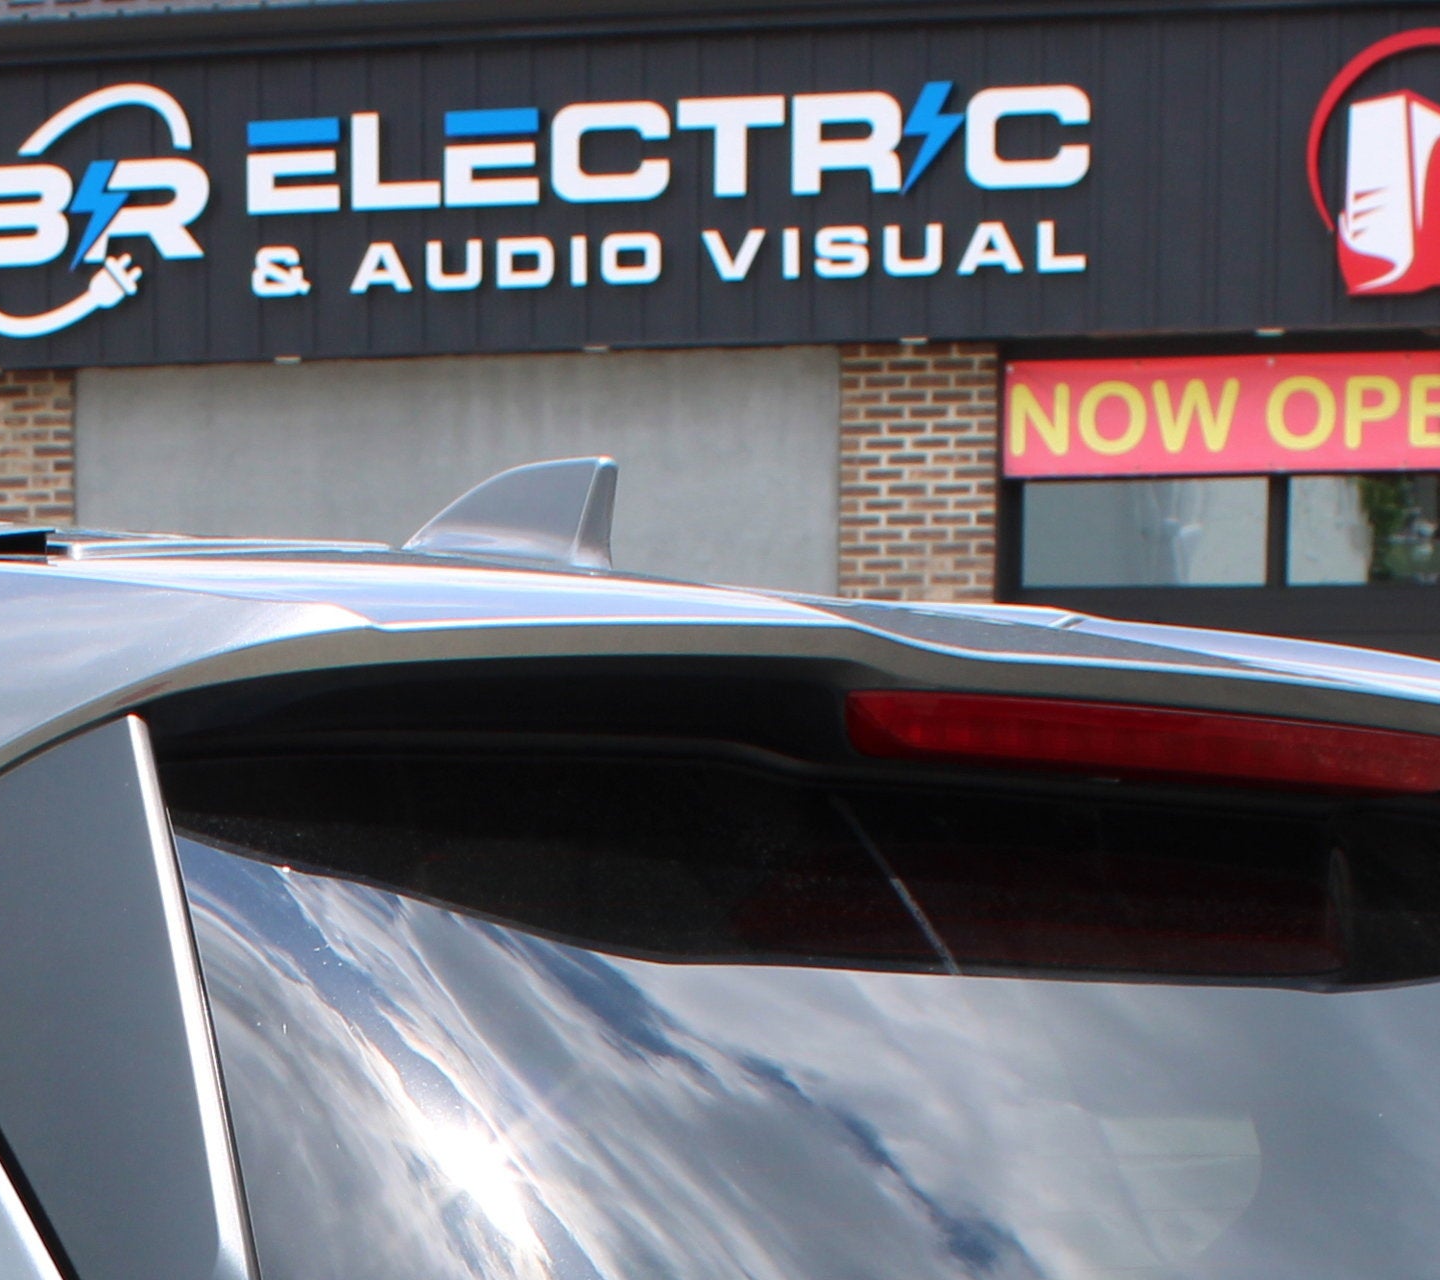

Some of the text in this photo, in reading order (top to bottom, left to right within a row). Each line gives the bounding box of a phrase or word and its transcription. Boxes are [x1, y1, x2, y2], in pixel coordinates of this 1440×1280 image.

[246, 80, 1091, 217] ELECTRIC
[251, 219, 1087, 298] & AUDIO VISUAL
[1010, 377, 1239, 456] NOW
